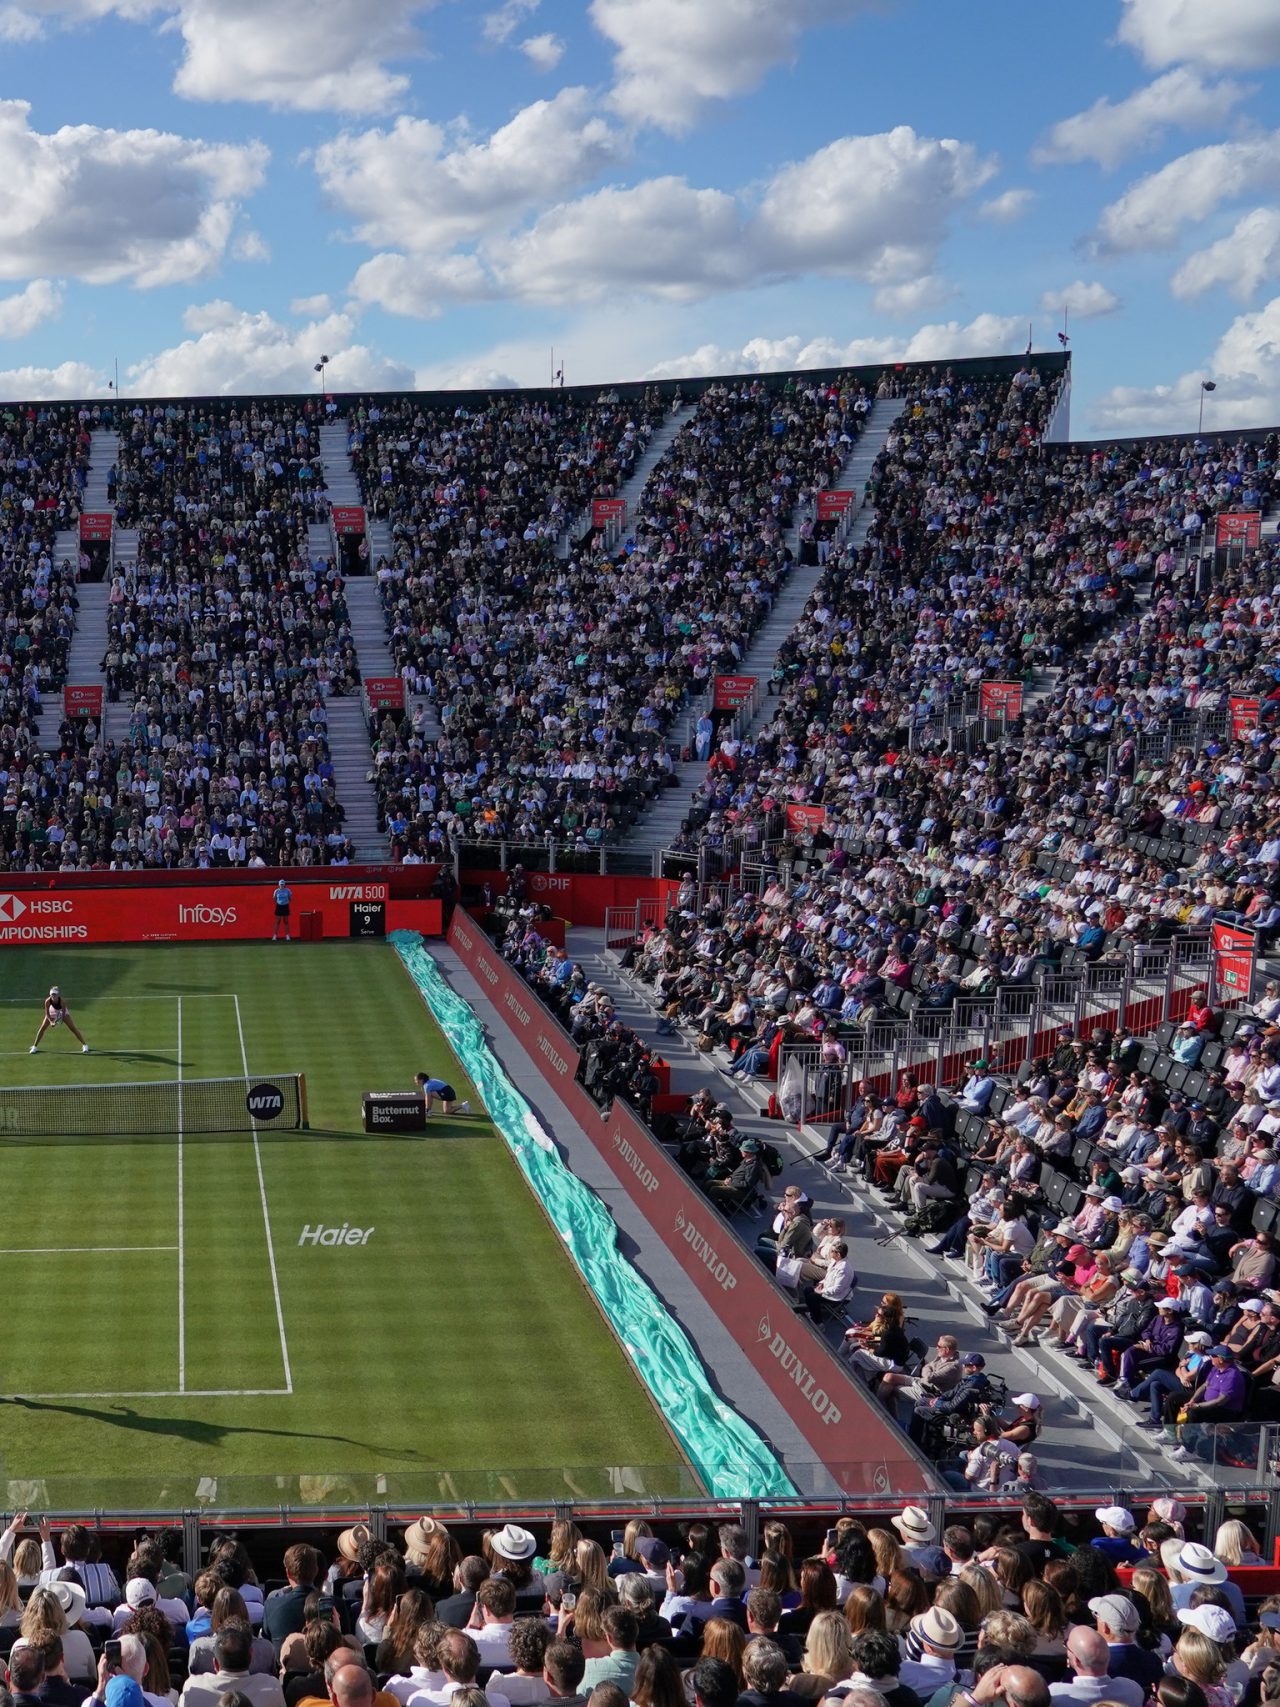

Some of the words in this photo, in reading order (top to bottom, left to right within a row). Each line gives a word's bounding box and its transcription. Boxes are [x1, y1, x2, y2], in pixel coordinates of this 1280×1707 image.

[548, 878, 571, 890] PIF
[330, 886, 363, 899] WTA
[365, 885, 385, 899] 500
[30, 900, 73, 914] HSBC
[179, 903, 237, 926] Infosys
[354, 903, 382, 912] Haier
[364, 915, 371, 925] 9
[508, 994, 531, 1026] DUNLOP
[540, 1036, 568, 1075] DUNLOP
[249, 1095, 281, 1110] WTA
[372, 1106, 419, 1115] Butternut
[372, 1115, 394, 1123] Box.
[618, 1138, 660, 1192] DUNLOP
[298, 1222, 375, 1246] Haier
[682, 1222, 737, 1291] DUNLOP
[768, 1332, 842, 1425] DUNLOP
